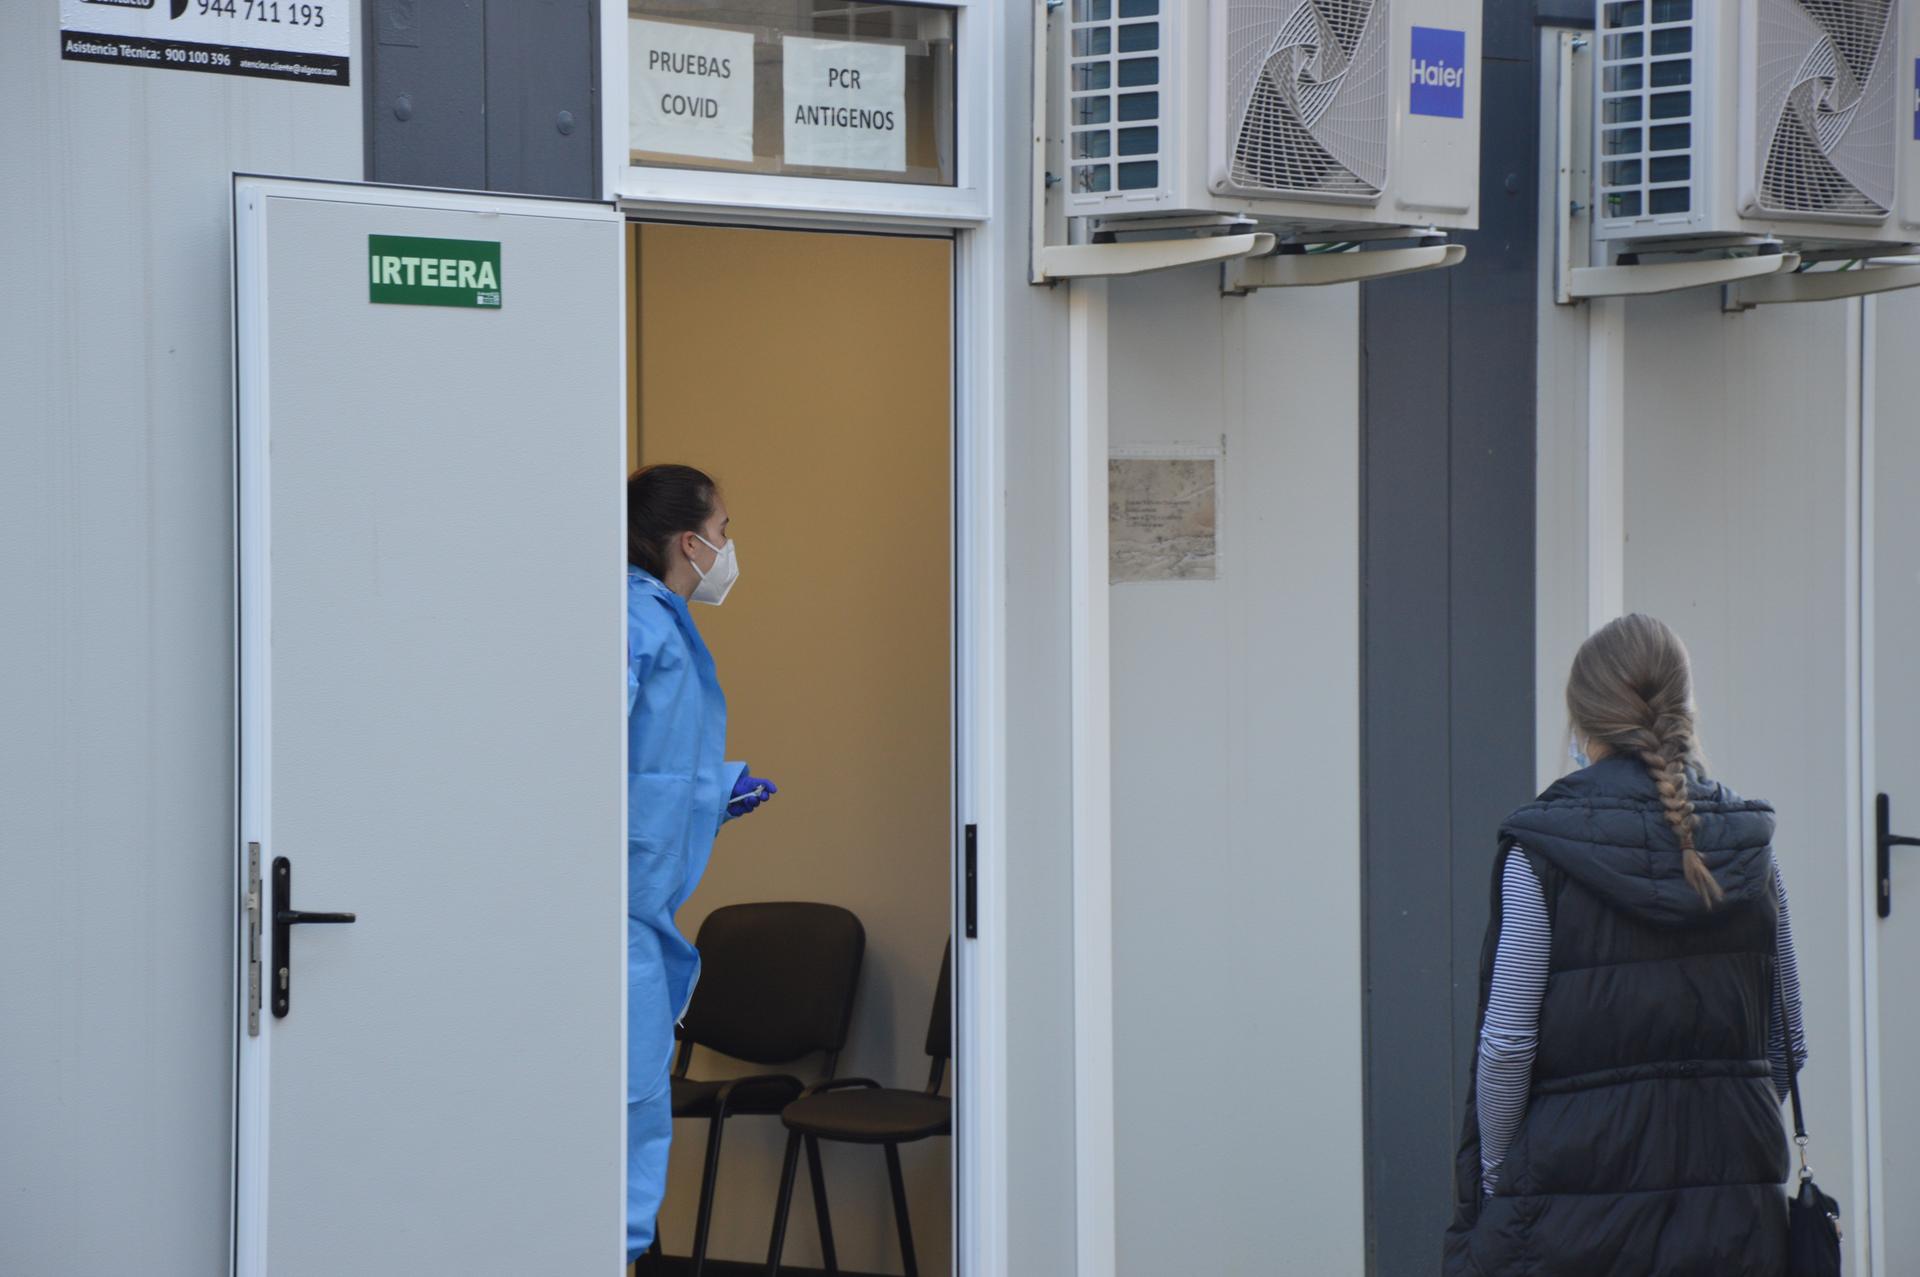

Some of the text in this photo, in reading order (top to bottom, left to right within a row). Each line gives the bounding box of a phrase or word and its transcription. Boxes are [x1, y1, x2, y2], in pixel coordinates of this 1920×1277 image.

[197, 0, 324, 28] 944 711 193
[66, 40, 118, 56] Asistencia
[119, 44, 161, 60] Técnica:
[165, 49, 186, 62] 900
[188, 51, 209, 64] 100
[211, 53, 231, 66] 396
[648, 50, 731, 79] PRUEBAS
[828, 68, 861, 90] PCR
[1411, 58, 1463, 88] Haier
[661, 94, 718, 119] COVID
[794, 104, 895, 131] ANTIGENOS
[371, 255, 498, 290] IRTEERA
